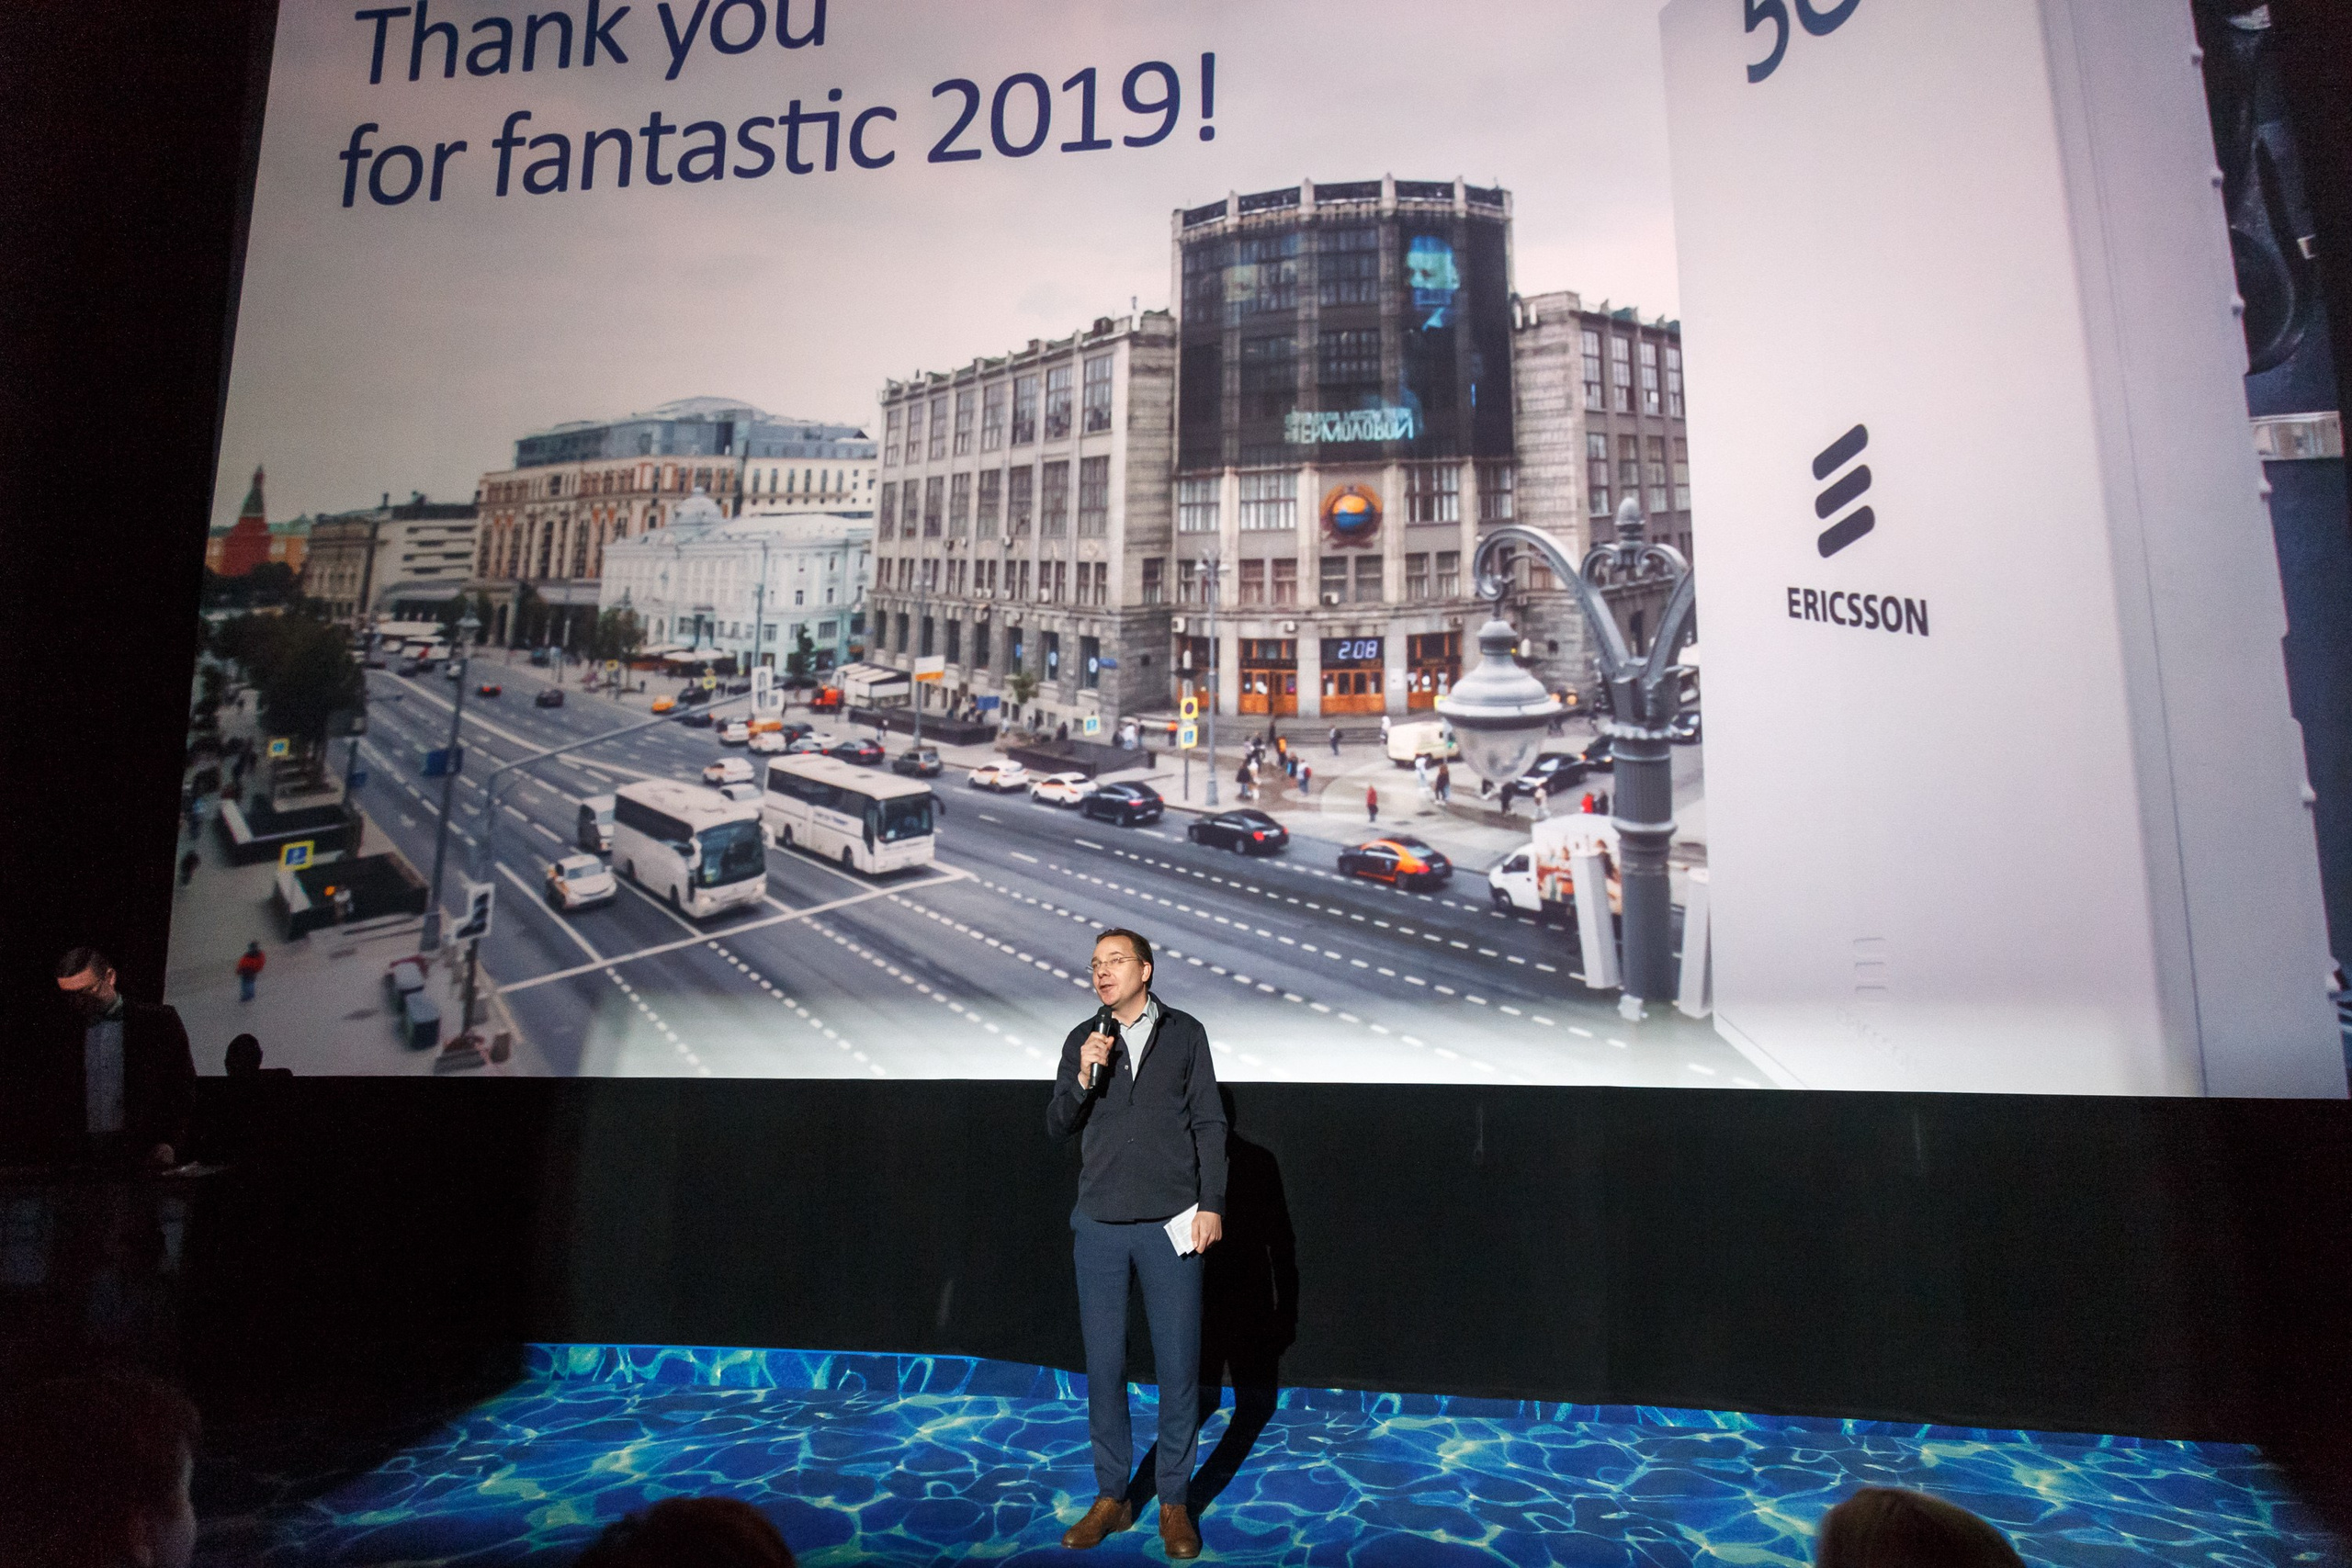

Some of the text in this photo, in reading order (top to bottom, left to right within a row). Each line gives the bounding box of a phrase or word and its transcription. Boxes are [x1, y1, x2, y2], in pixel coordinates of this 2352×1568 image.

[355, 0, 827, 85] Thank you
[339, 52, 1216, 209] for fantastic 2019!
[1787, 586, 1929, 637] ERICSSON
